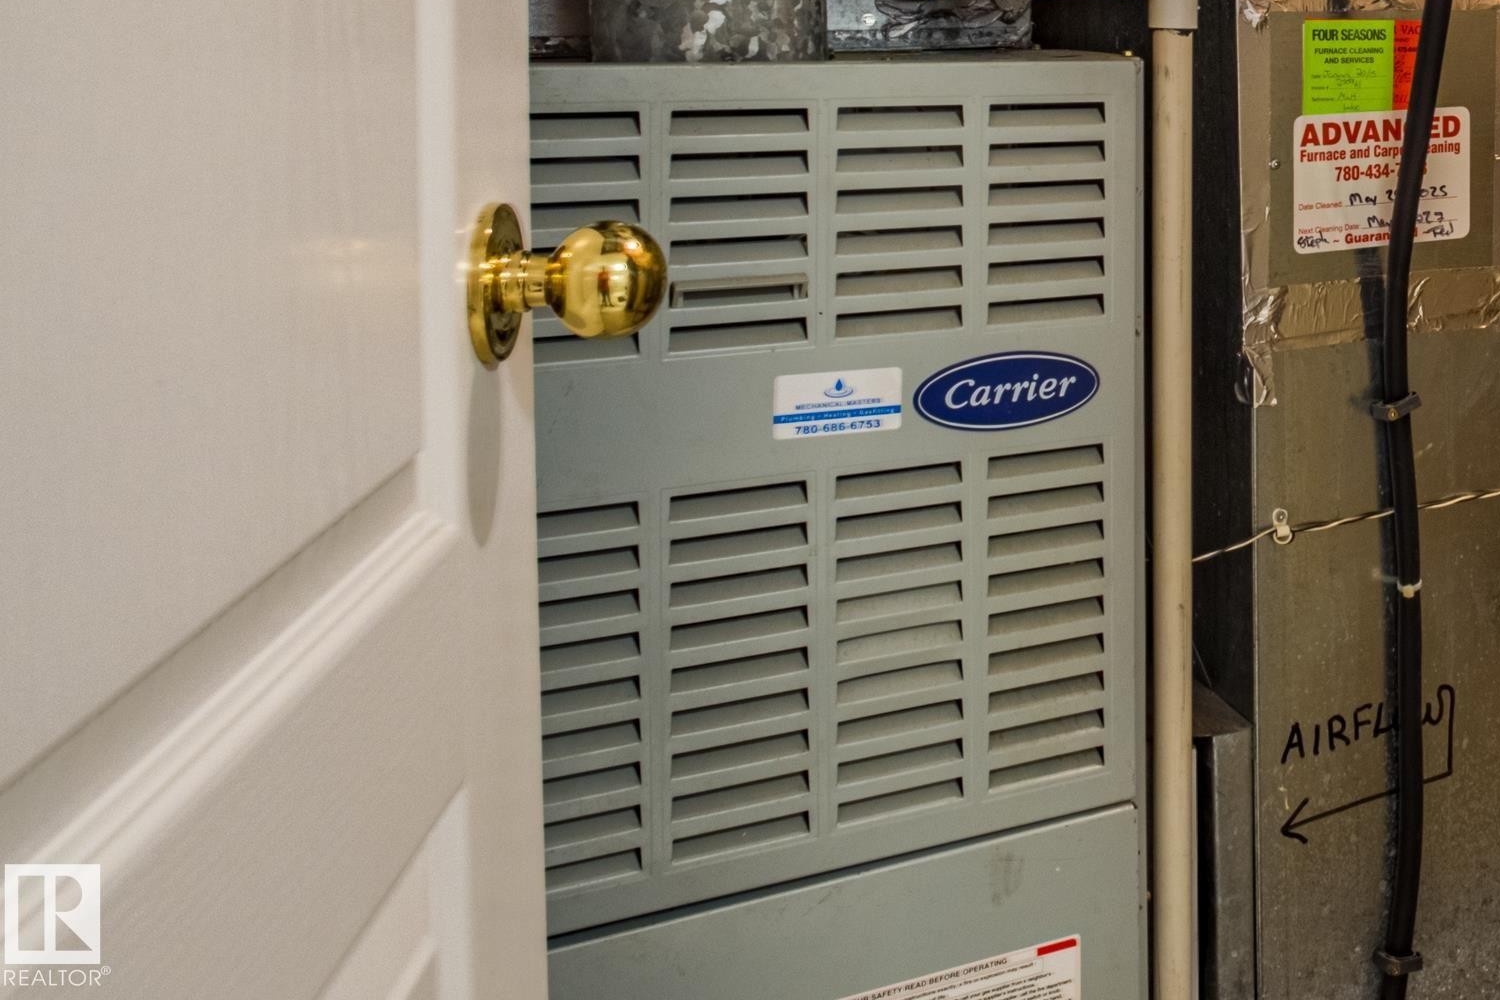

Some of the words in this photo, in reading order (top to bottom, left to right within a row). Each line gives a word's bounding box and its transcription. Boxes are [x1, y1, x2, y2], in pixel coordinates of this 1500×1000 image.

[1312, 28, 1339, 41] FOUR
[1340, 28, 1387, 41] SEASONS
[1314, 47, 1348, 55] FURNACE
[1300, 115, 1461, 148] ADVANED
[1300, 149, 1346, 163] Furnace
[1350, 146, 1370, 159] and
[1373, 144, 1405, 159] Carp
[1426, 140, 1461, 155] aning
[1335, 161, 1428, 182] 780-434-
[1349, 192, 1377, 206] May
[1419, 184, 1449, 198] 025
[1298, 203, 1314, 211] Date
[1415, 210, 1445, 224] 027
[1298, 227, 1315, 235] Next
[1314, 225, 1344, 235] Cleaning
[944, 373, 1077, 410] Carrier
[795, 401, 842, 411] MECHANICAL
[846, 398, 881, 406] MASTERS
[781, 413, 815, 423] Plumbing
[823, 410, 852, 418] Heating
[1280, 686, 1447, 765] AIRFLW
[904, 980, 926, 992] READ
[929, 970, 960, 985] BEFORE
[962, 958, 1008, 976] OPERATING
